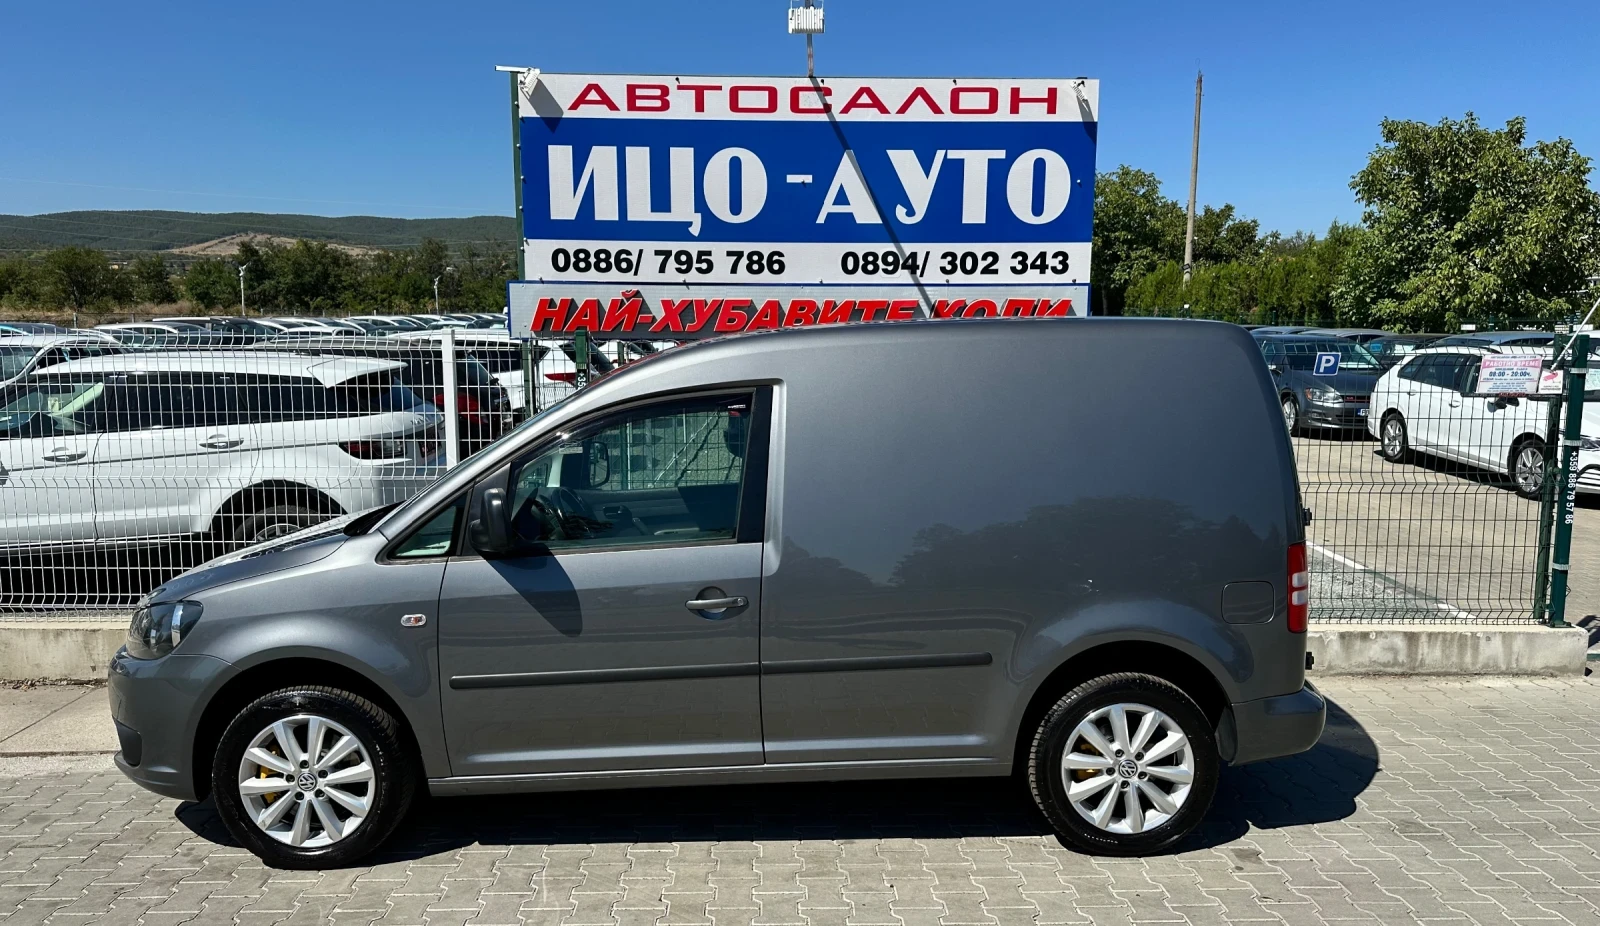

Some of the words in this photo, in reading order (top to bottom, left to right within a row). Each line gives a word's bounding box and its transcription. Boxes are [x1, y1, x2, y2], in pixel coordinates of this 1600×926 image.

[567, 83, 1058, 115] АВТОСАЛОН
[547, 144, 768, 237] ИЦО
[551, 248, 644, 276] 0886/
[654, 249, 714, 275] 795
[726, 250, 786, 275] 786
[841, 251, 930, 277] 0894/
[939, 251, 1000, 276] 302
[1009, 251, 1070, 276] 343
[530, 289, 919, 332] НАЙ-ХУБАВИТЕ
[1319, 356, 1335, 372] P
[1569, 451, 1578, 471] +359
[1568, 474, 1577, 488] 886
[1566, 490, 1575, 500] 79
[1566, 502, 1574, 512] 57
[1564, 514, 1574, 524] 86
